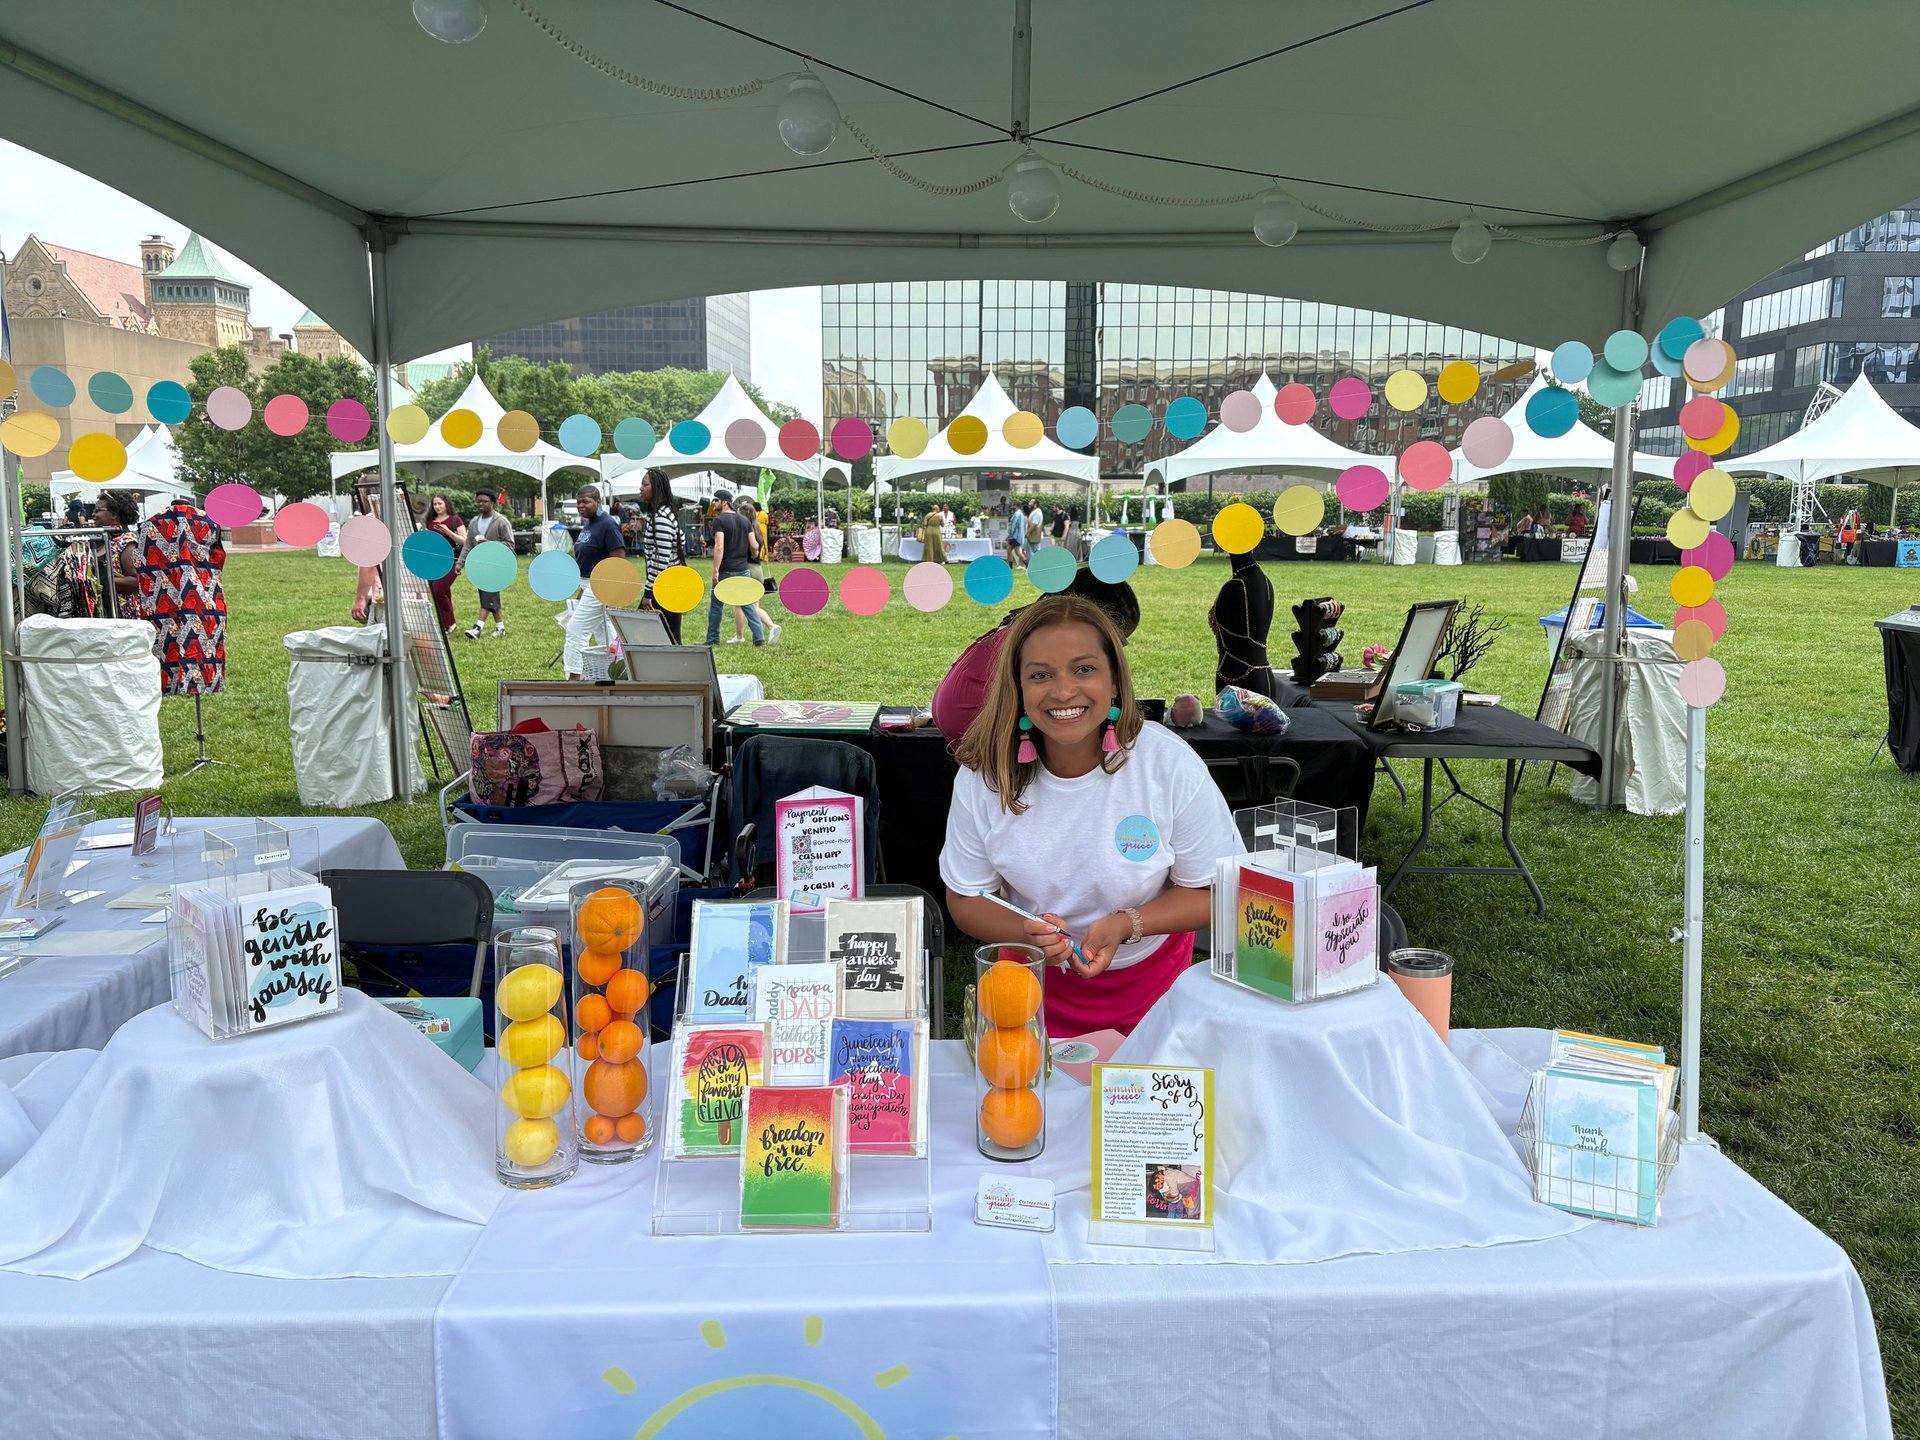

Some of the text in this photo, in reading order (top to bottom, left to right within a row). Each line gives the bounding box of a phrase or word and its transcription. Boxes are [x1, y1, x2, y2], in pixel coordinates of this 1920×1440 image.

[785, 806, 829, 824] Payment
[812, 814, 850, 823] OPTIONS
[252, 907, 297, 932] be
[1244, 902, 1288, 932] freedom
[1324, 900, 1369, 952] appreciate
[1342, 913, 1352, 926] so
[1264, 924, 1282, 940] not
[245, 920, 333, 966] gentle
[848, 934, 888, 956] happy
[1339, 931, 1360, 964] you
[267, 943, 332, 972] with
[856, 968, 880, 989] day
[249, 971, 337, 1023] yourself
[786, 984, 833, 998] papa
[780, 998, 832, 1020] DAD
[773, 1048, 816, 1064] POPS
[838, 1030, 904, 1065] Juneteenth
[716, 1074, 741, 1087] is my
[848, 1063, 899, 1082] freedom
[1152, 1072, 1196, 1098] Story
[890, 1090, 906, 1106] Day
[1168, 1090, 1181, 1104] of
[760, 1120, 824, 1150] freedom
[1572, 1125, 1604, 1138] Thank
[1580, 1136, 1596, 1145] you
[777, 1143, 817, 1157] is not
